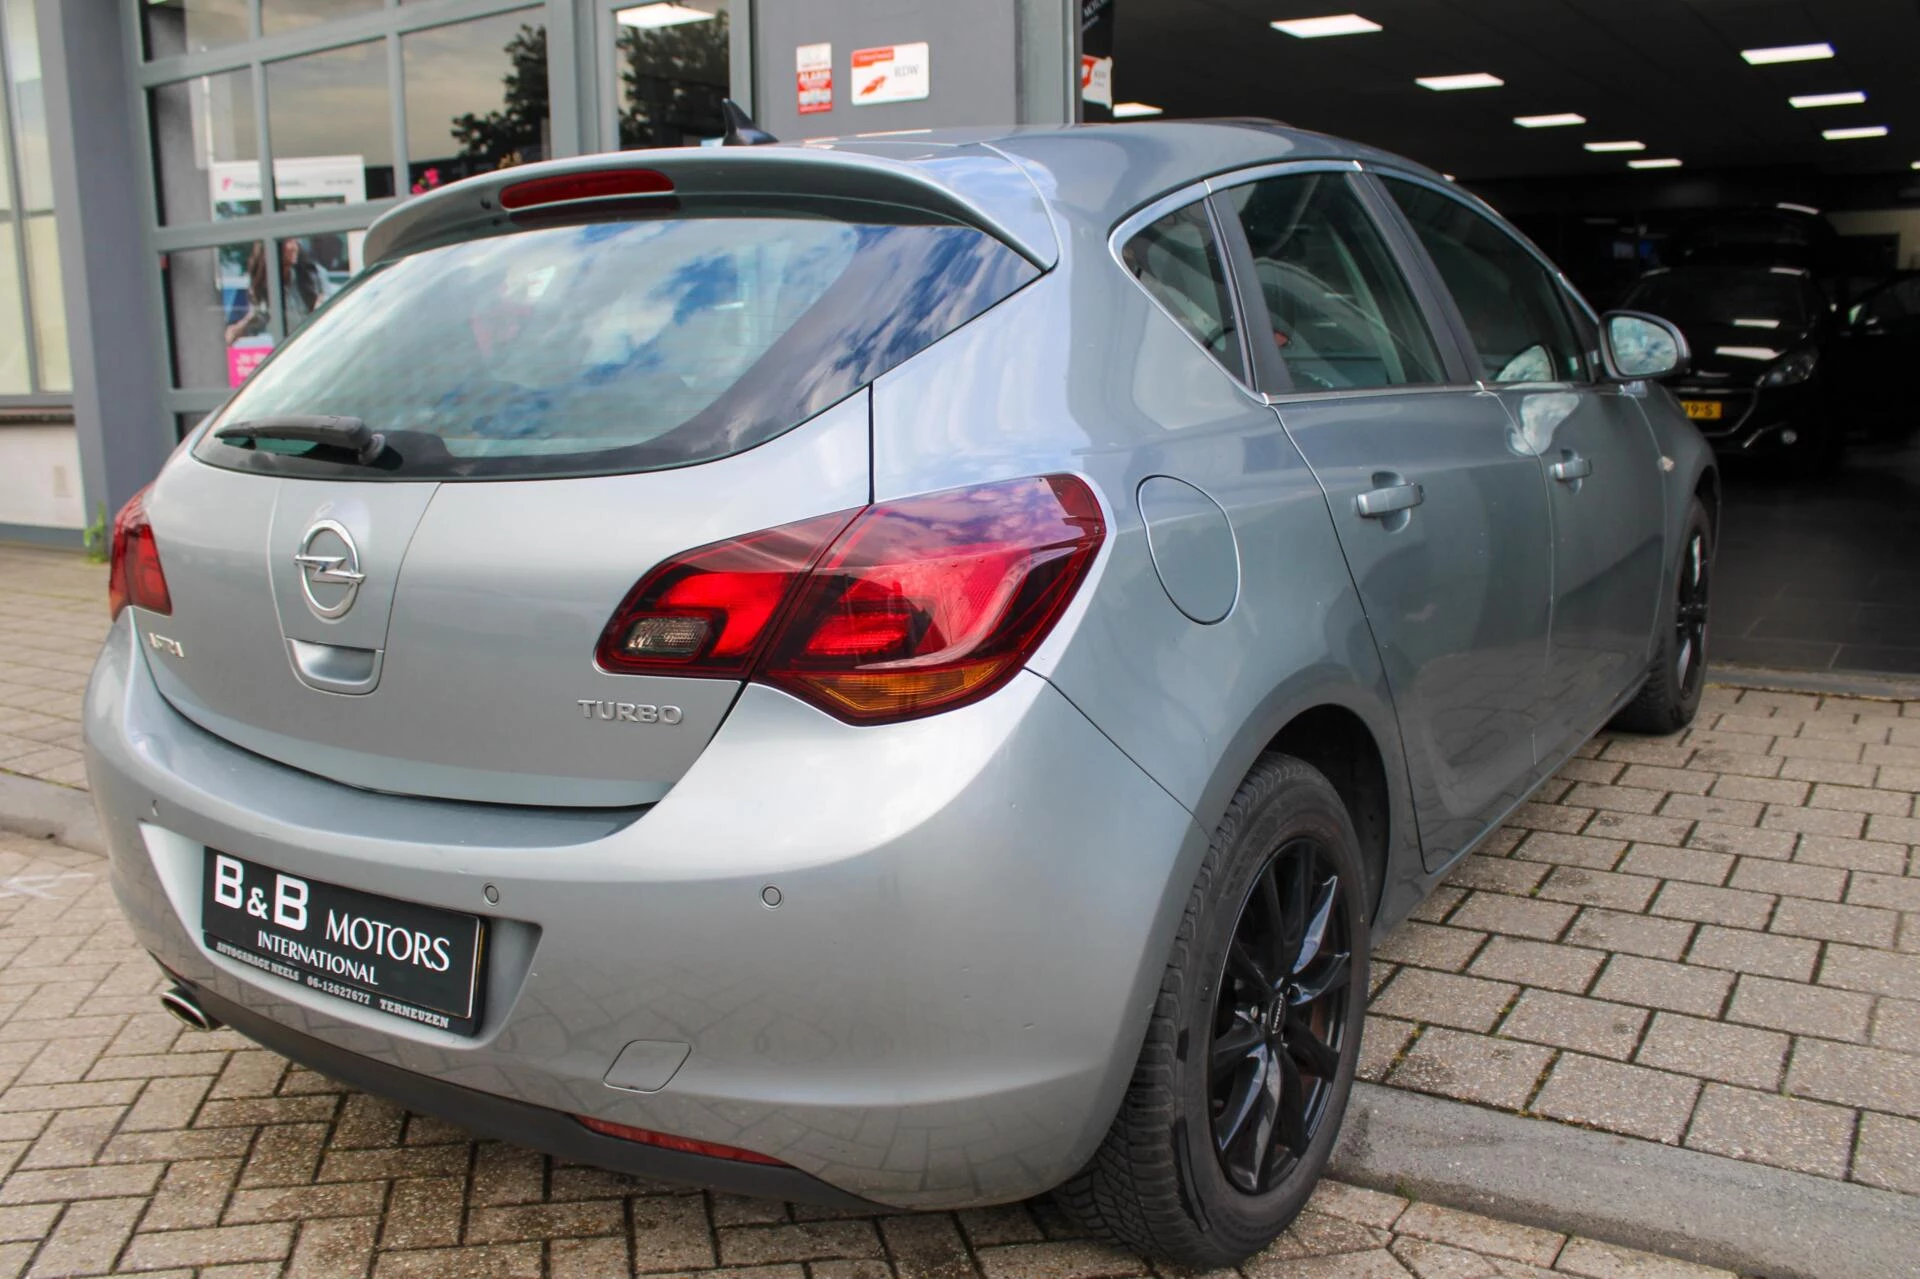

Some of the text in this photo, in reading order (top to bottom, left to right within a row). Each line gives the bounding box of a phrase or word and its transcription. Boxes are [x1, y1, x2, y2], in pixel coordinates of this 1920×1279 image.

[577, 699, 683, 725] TURBO
[257, 930, 379, 986] INTERNATIONAL
[324, 908, 451, 972] MOTORS
[379, 998, 449, 1029] TERNEUZEN
